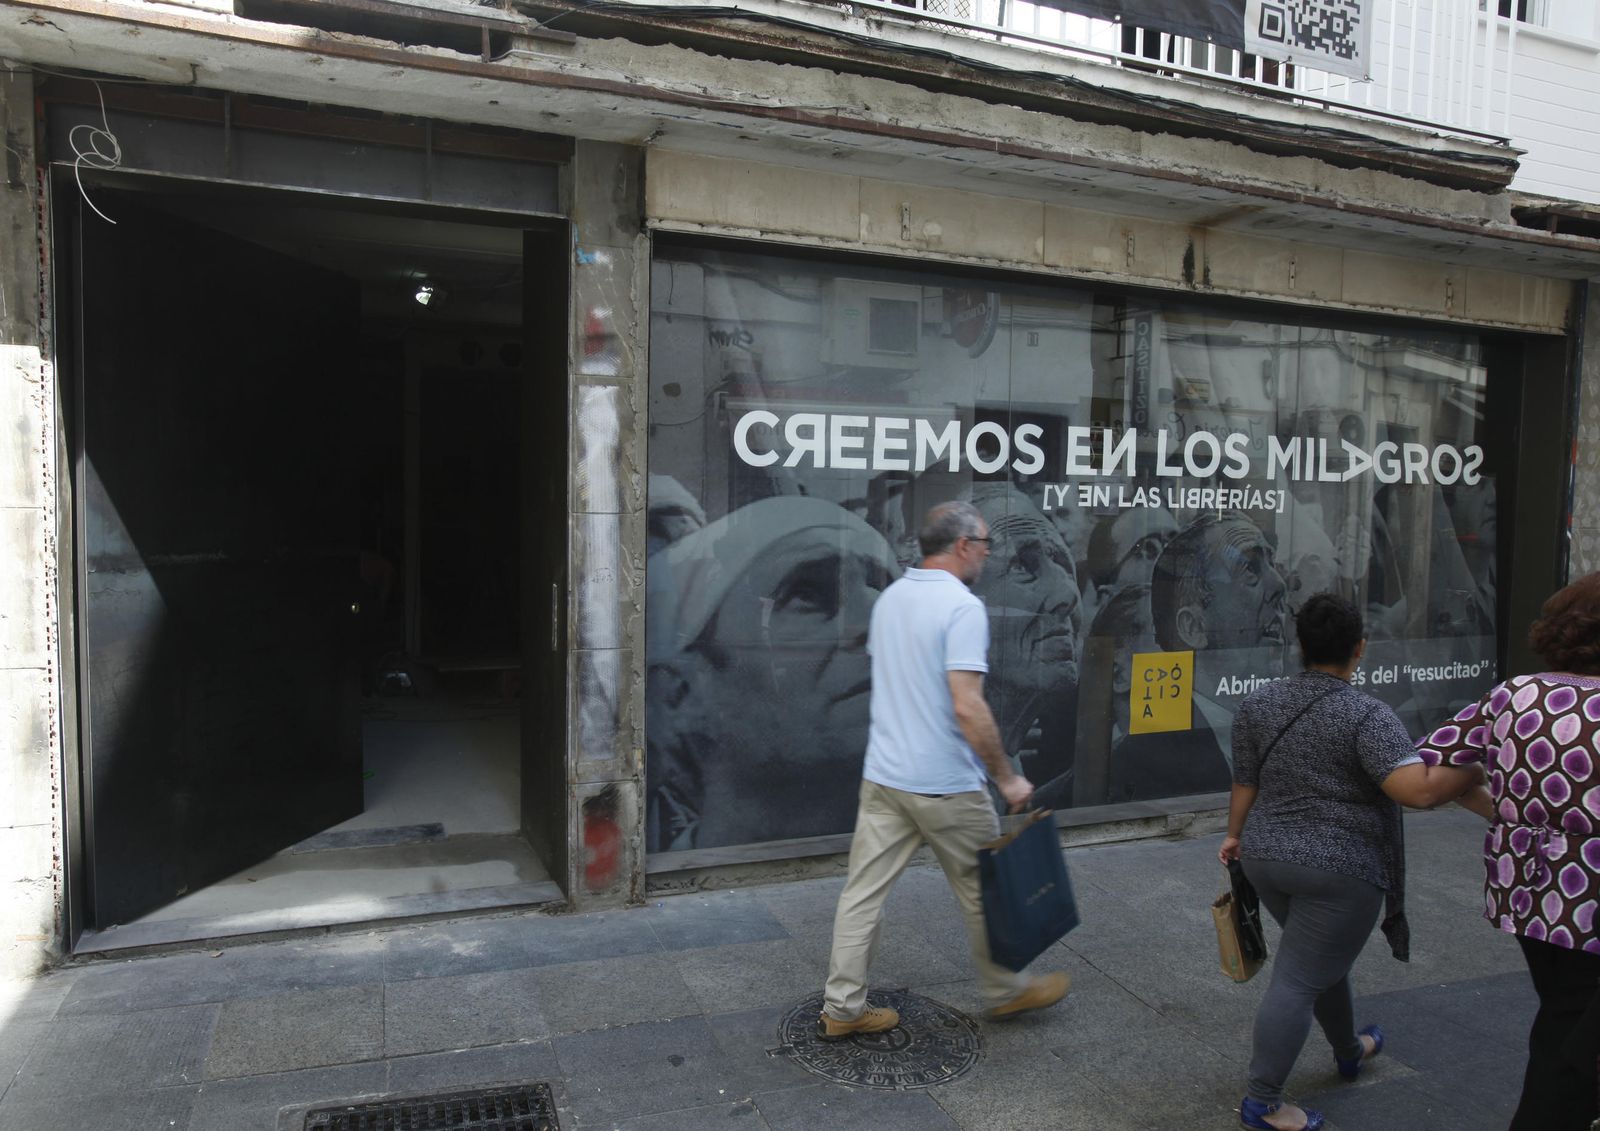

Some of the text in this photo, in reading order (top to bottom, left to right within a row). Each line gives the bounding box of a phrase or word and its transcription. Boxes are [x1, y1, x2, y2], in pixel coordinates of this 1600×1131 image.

[733, 410, 1045, 475] CREEMOS
[1066, 425, 1137, 477] EN
[1156, 428, 1250, 480] LOS
[1266, 435, 1484, 486] MILAGROS
[1078, 485, 1111, 508] EN
[1118, 487, 1161, 508] LAS
[1168, 484, 1285, 513] LIBRERÍAS]
[1371, 665, 1398, 685] del
[1402, 659, 1489, 683] “resucitao”
